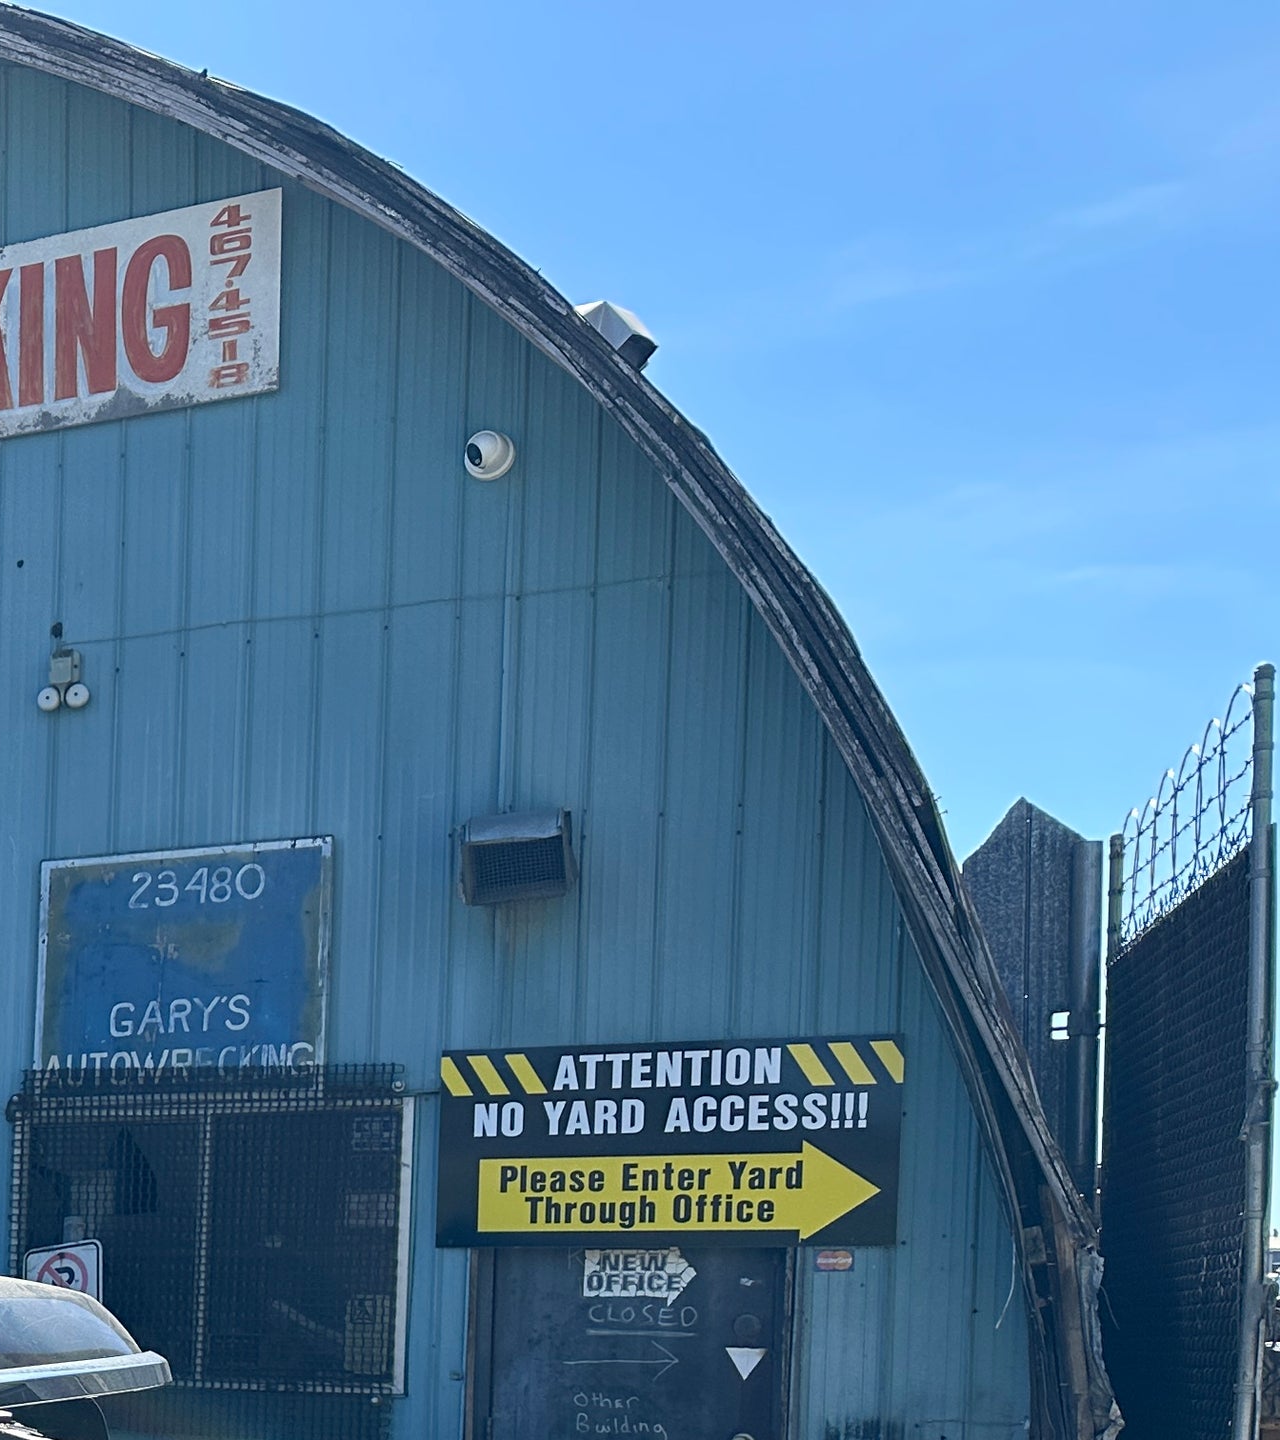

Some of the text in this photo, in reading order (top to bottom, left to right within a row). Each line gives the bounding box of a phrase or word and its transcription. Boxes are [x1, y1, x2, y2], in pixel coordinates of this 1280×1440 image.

[128, 863, 266, 909] 23480
[109, 994, 251, 1038] GARY'S
[553, 1047, 782, 1091] ATTENTION
[473, 1092, 868, 1138] NO YARD ACCESS!!!
[499, 1160, 803, 1194] Please Enter Yard
[525, 1194, 775, 1228] Through Office
[601, 1252, 666, 1272] NEW
[587, 1270, 681, 1292] OFFICE
[589, 1304, 698, 1327] CLOSED
